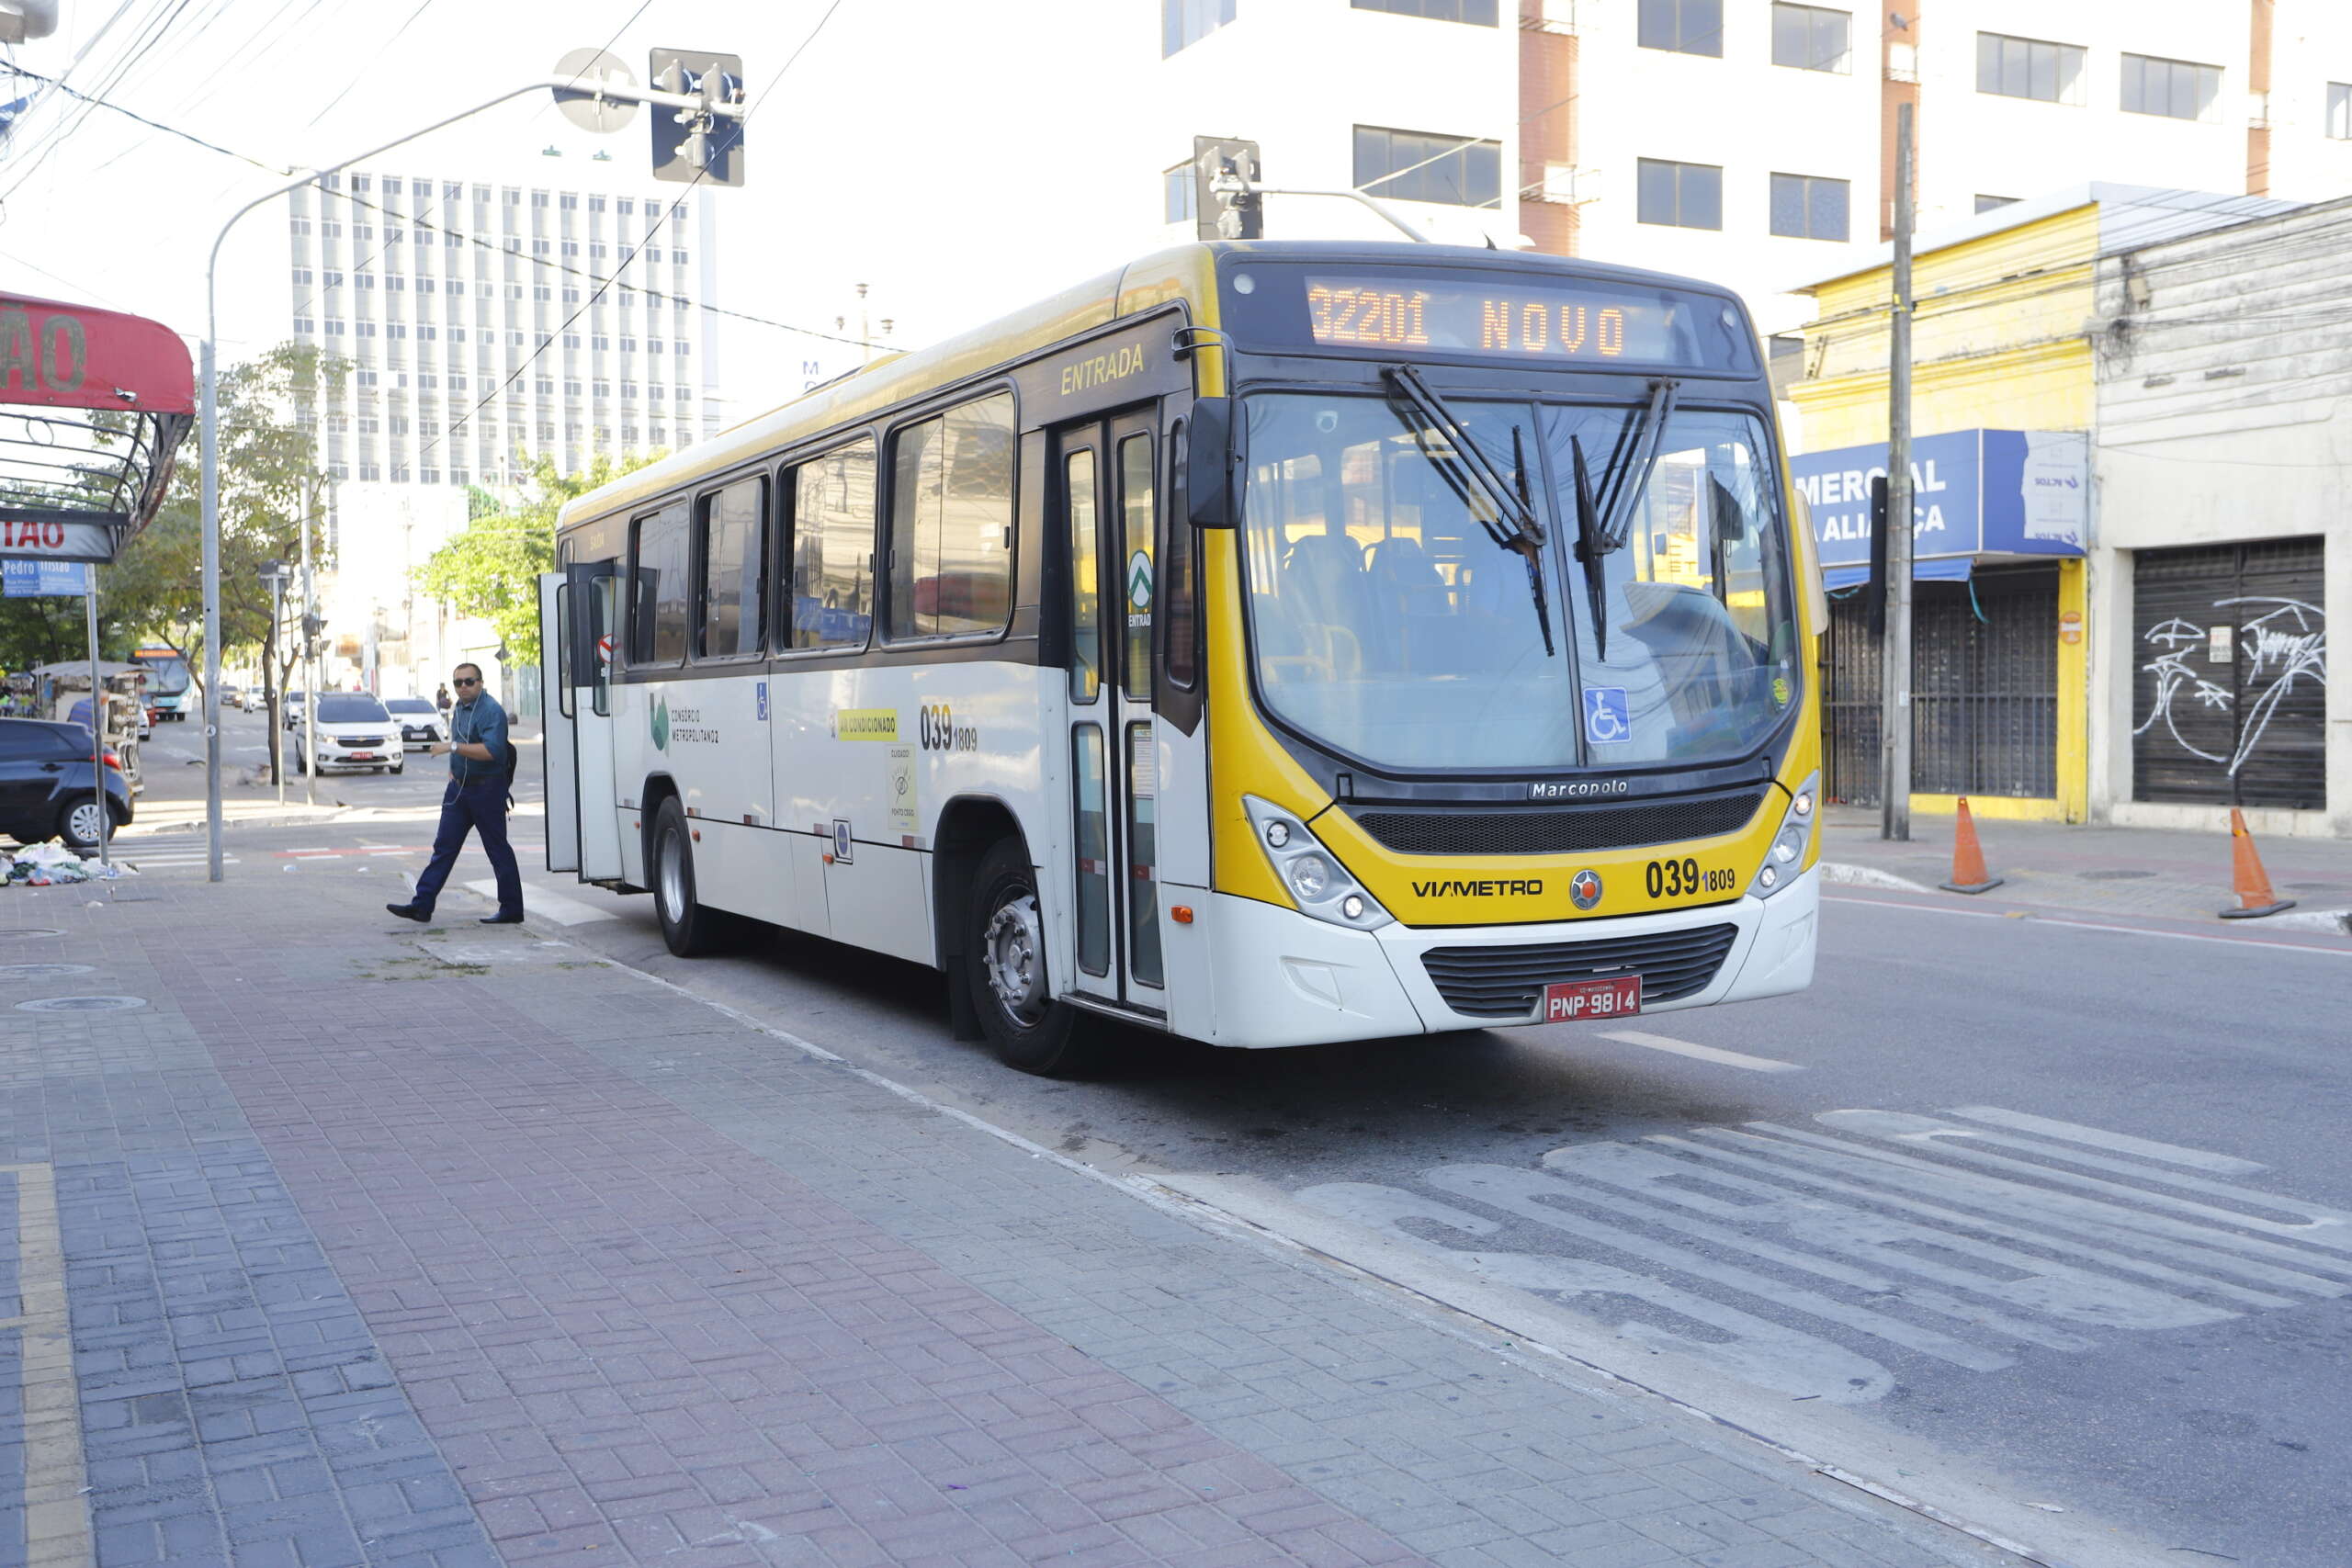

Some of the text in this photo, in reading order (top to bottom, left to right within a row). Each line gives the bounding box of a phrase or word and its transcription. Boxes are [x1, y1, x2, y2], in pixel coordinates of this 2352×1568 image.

[1308, 288, 1623, 355] 32201 NOVO
[1061, 344, 1144, 396] ENTRADA
[4, 560, 35, 575] Pedro
[849, 717, 896, 733] CONDICIONADO
[920, 705, 978, 752] 039 1809
[1532, 779, 1628, 797] Marcopolo
[1411, 879, 1544, 897] VIAMETRO
[1645, 858, 1736, 898] 039 1809
